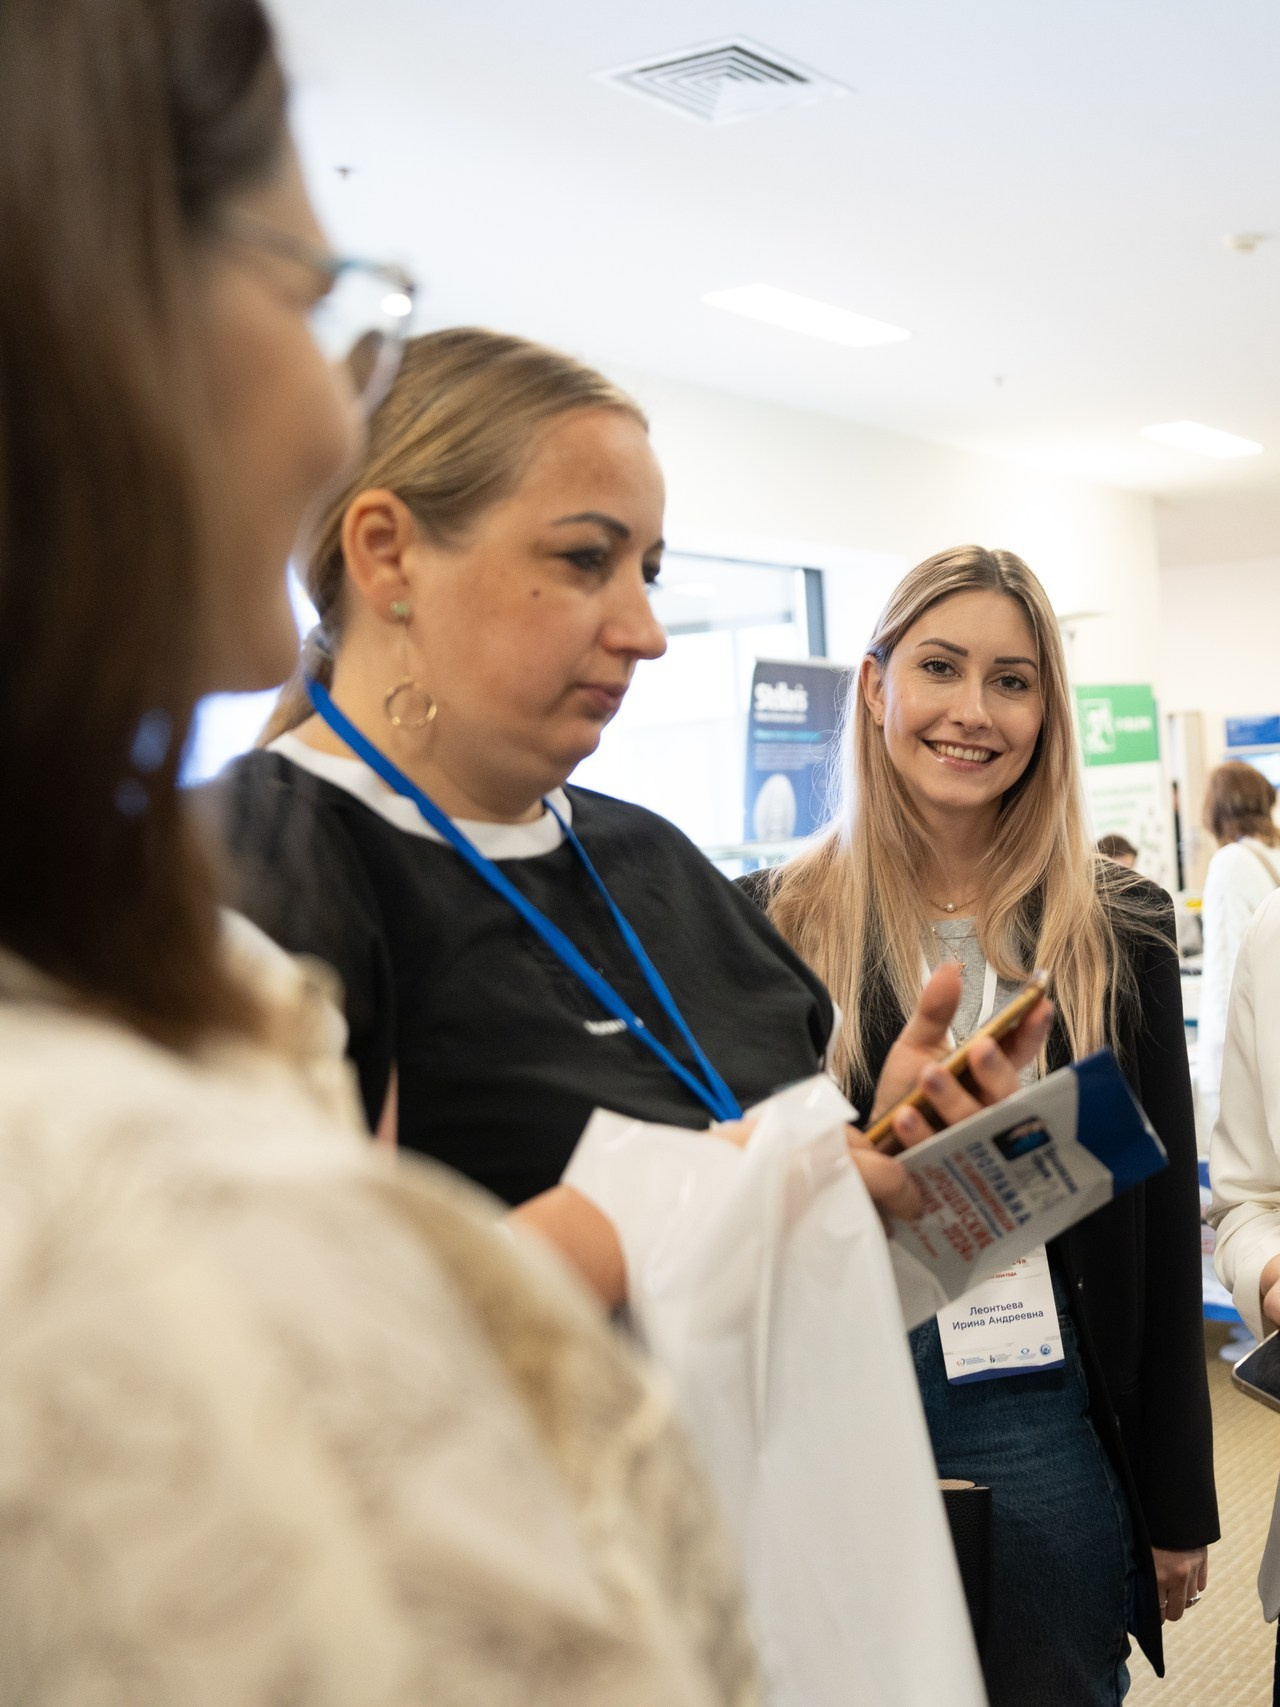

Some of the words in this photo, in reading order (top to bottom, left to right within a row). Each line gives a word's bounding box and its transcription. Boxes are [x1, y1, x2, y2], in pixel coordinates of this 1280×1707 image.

[969, 1301, 1024, 1316] Леонтьева
[952, 1319, 986, 1331] Ирина
[988, 1310, 1044, 1324] Андреевна
